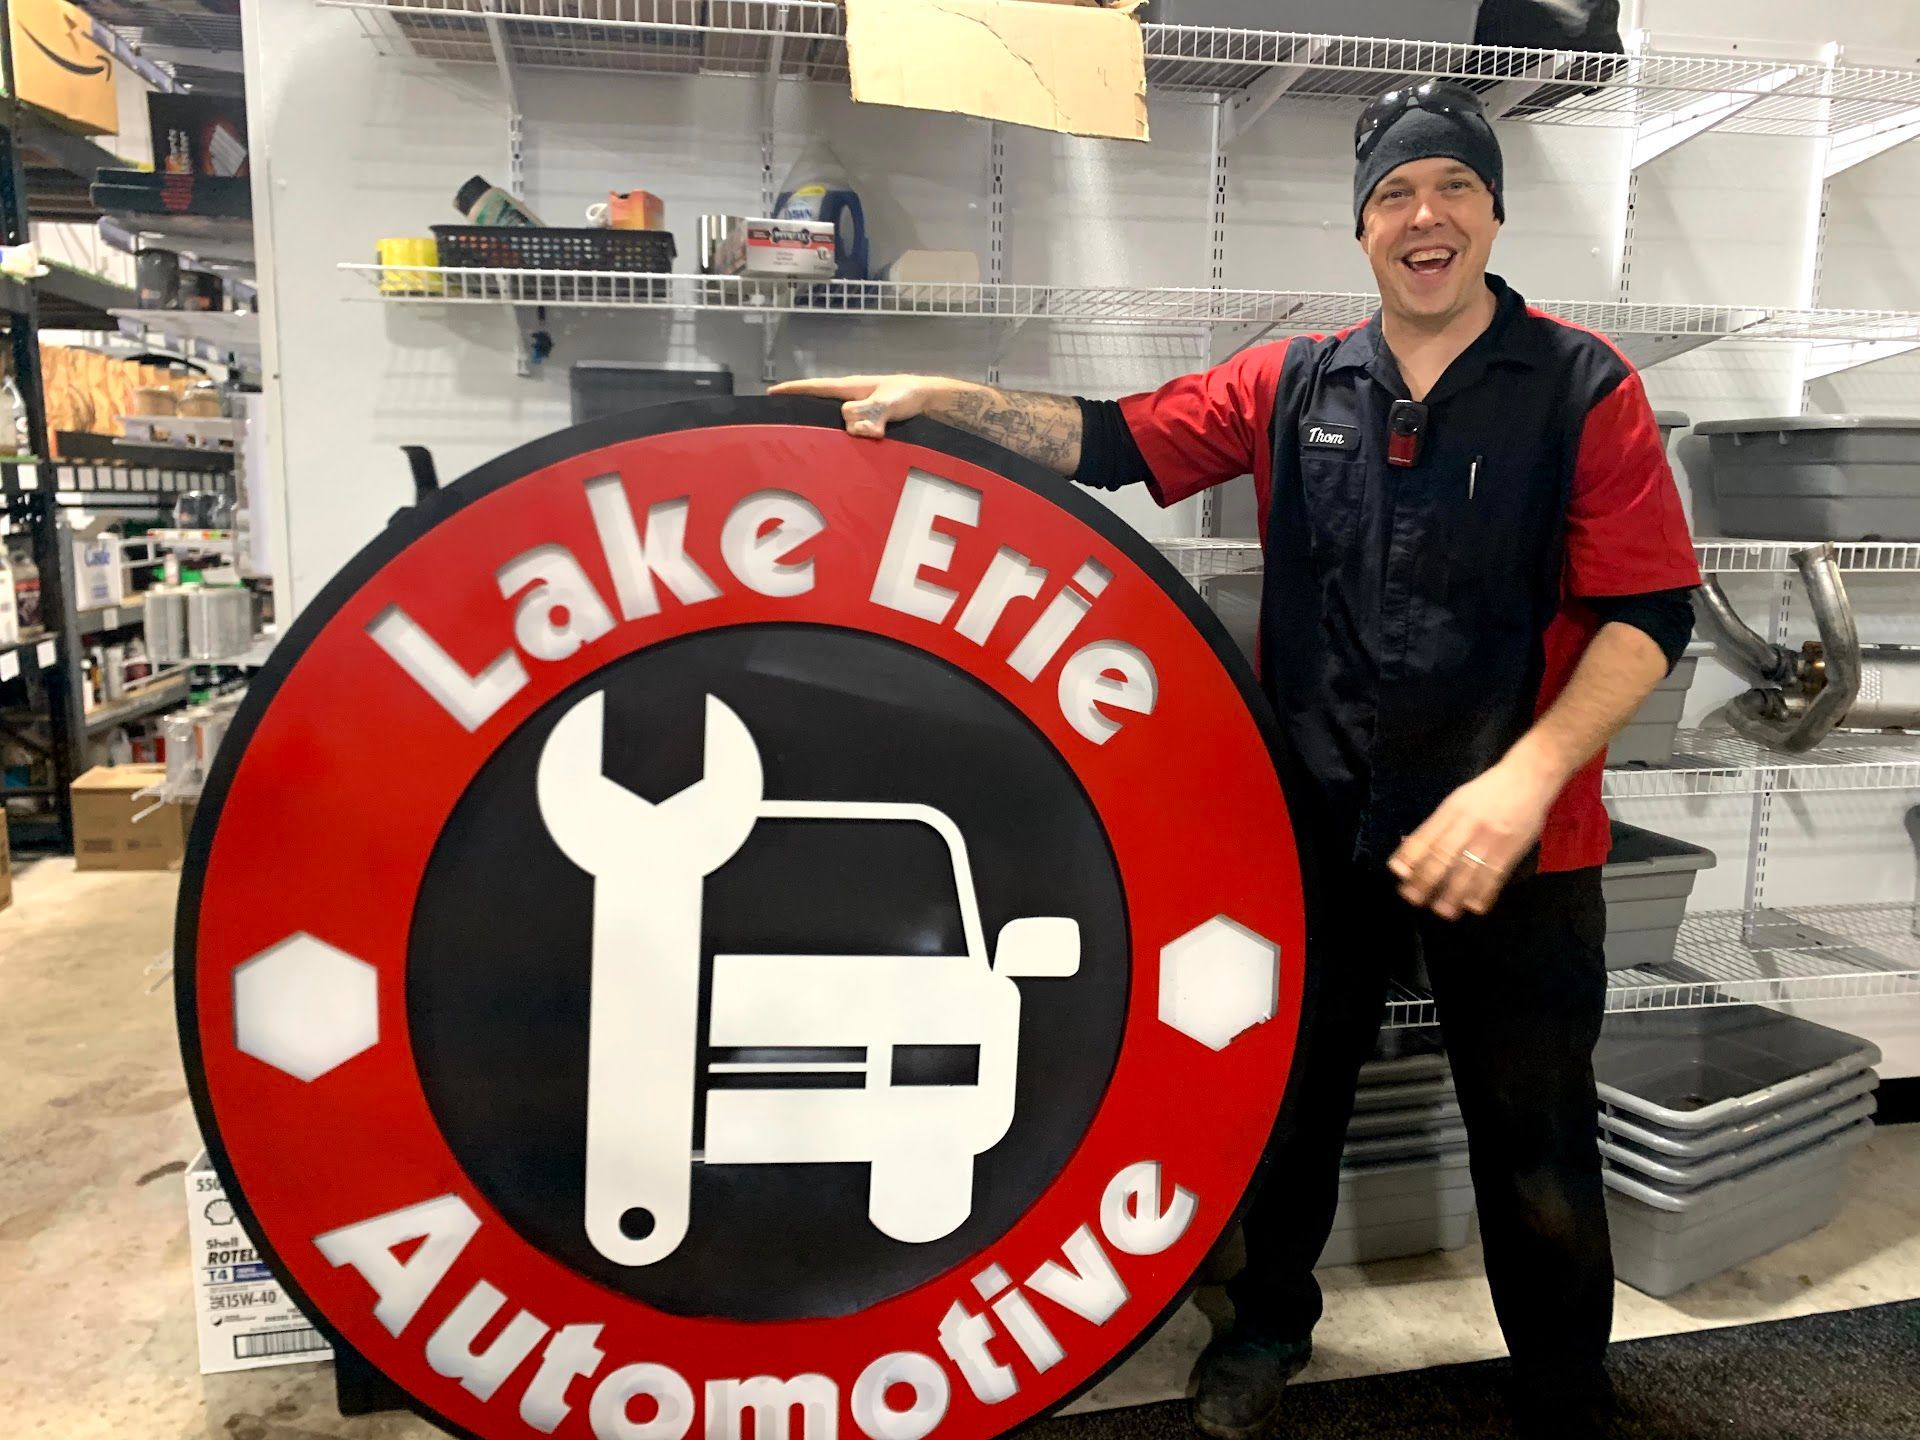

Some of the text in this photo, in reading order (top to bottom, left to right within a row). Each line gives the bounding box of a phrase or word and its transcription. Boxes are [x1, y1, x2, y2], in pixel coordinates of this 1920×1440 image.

[1308, 426, 1345, 445] Thom
[364, 466, 1160, 746] Lake Erie
[206, 1237, 239, 1250] Shell
[208, 1249, 261, 1266] ROTEL
[208, 1269, 228, 1282] T4
[226, 1291, 277, 1309] 15W-40
[310, 1159, 1200, 1440] Automotive
